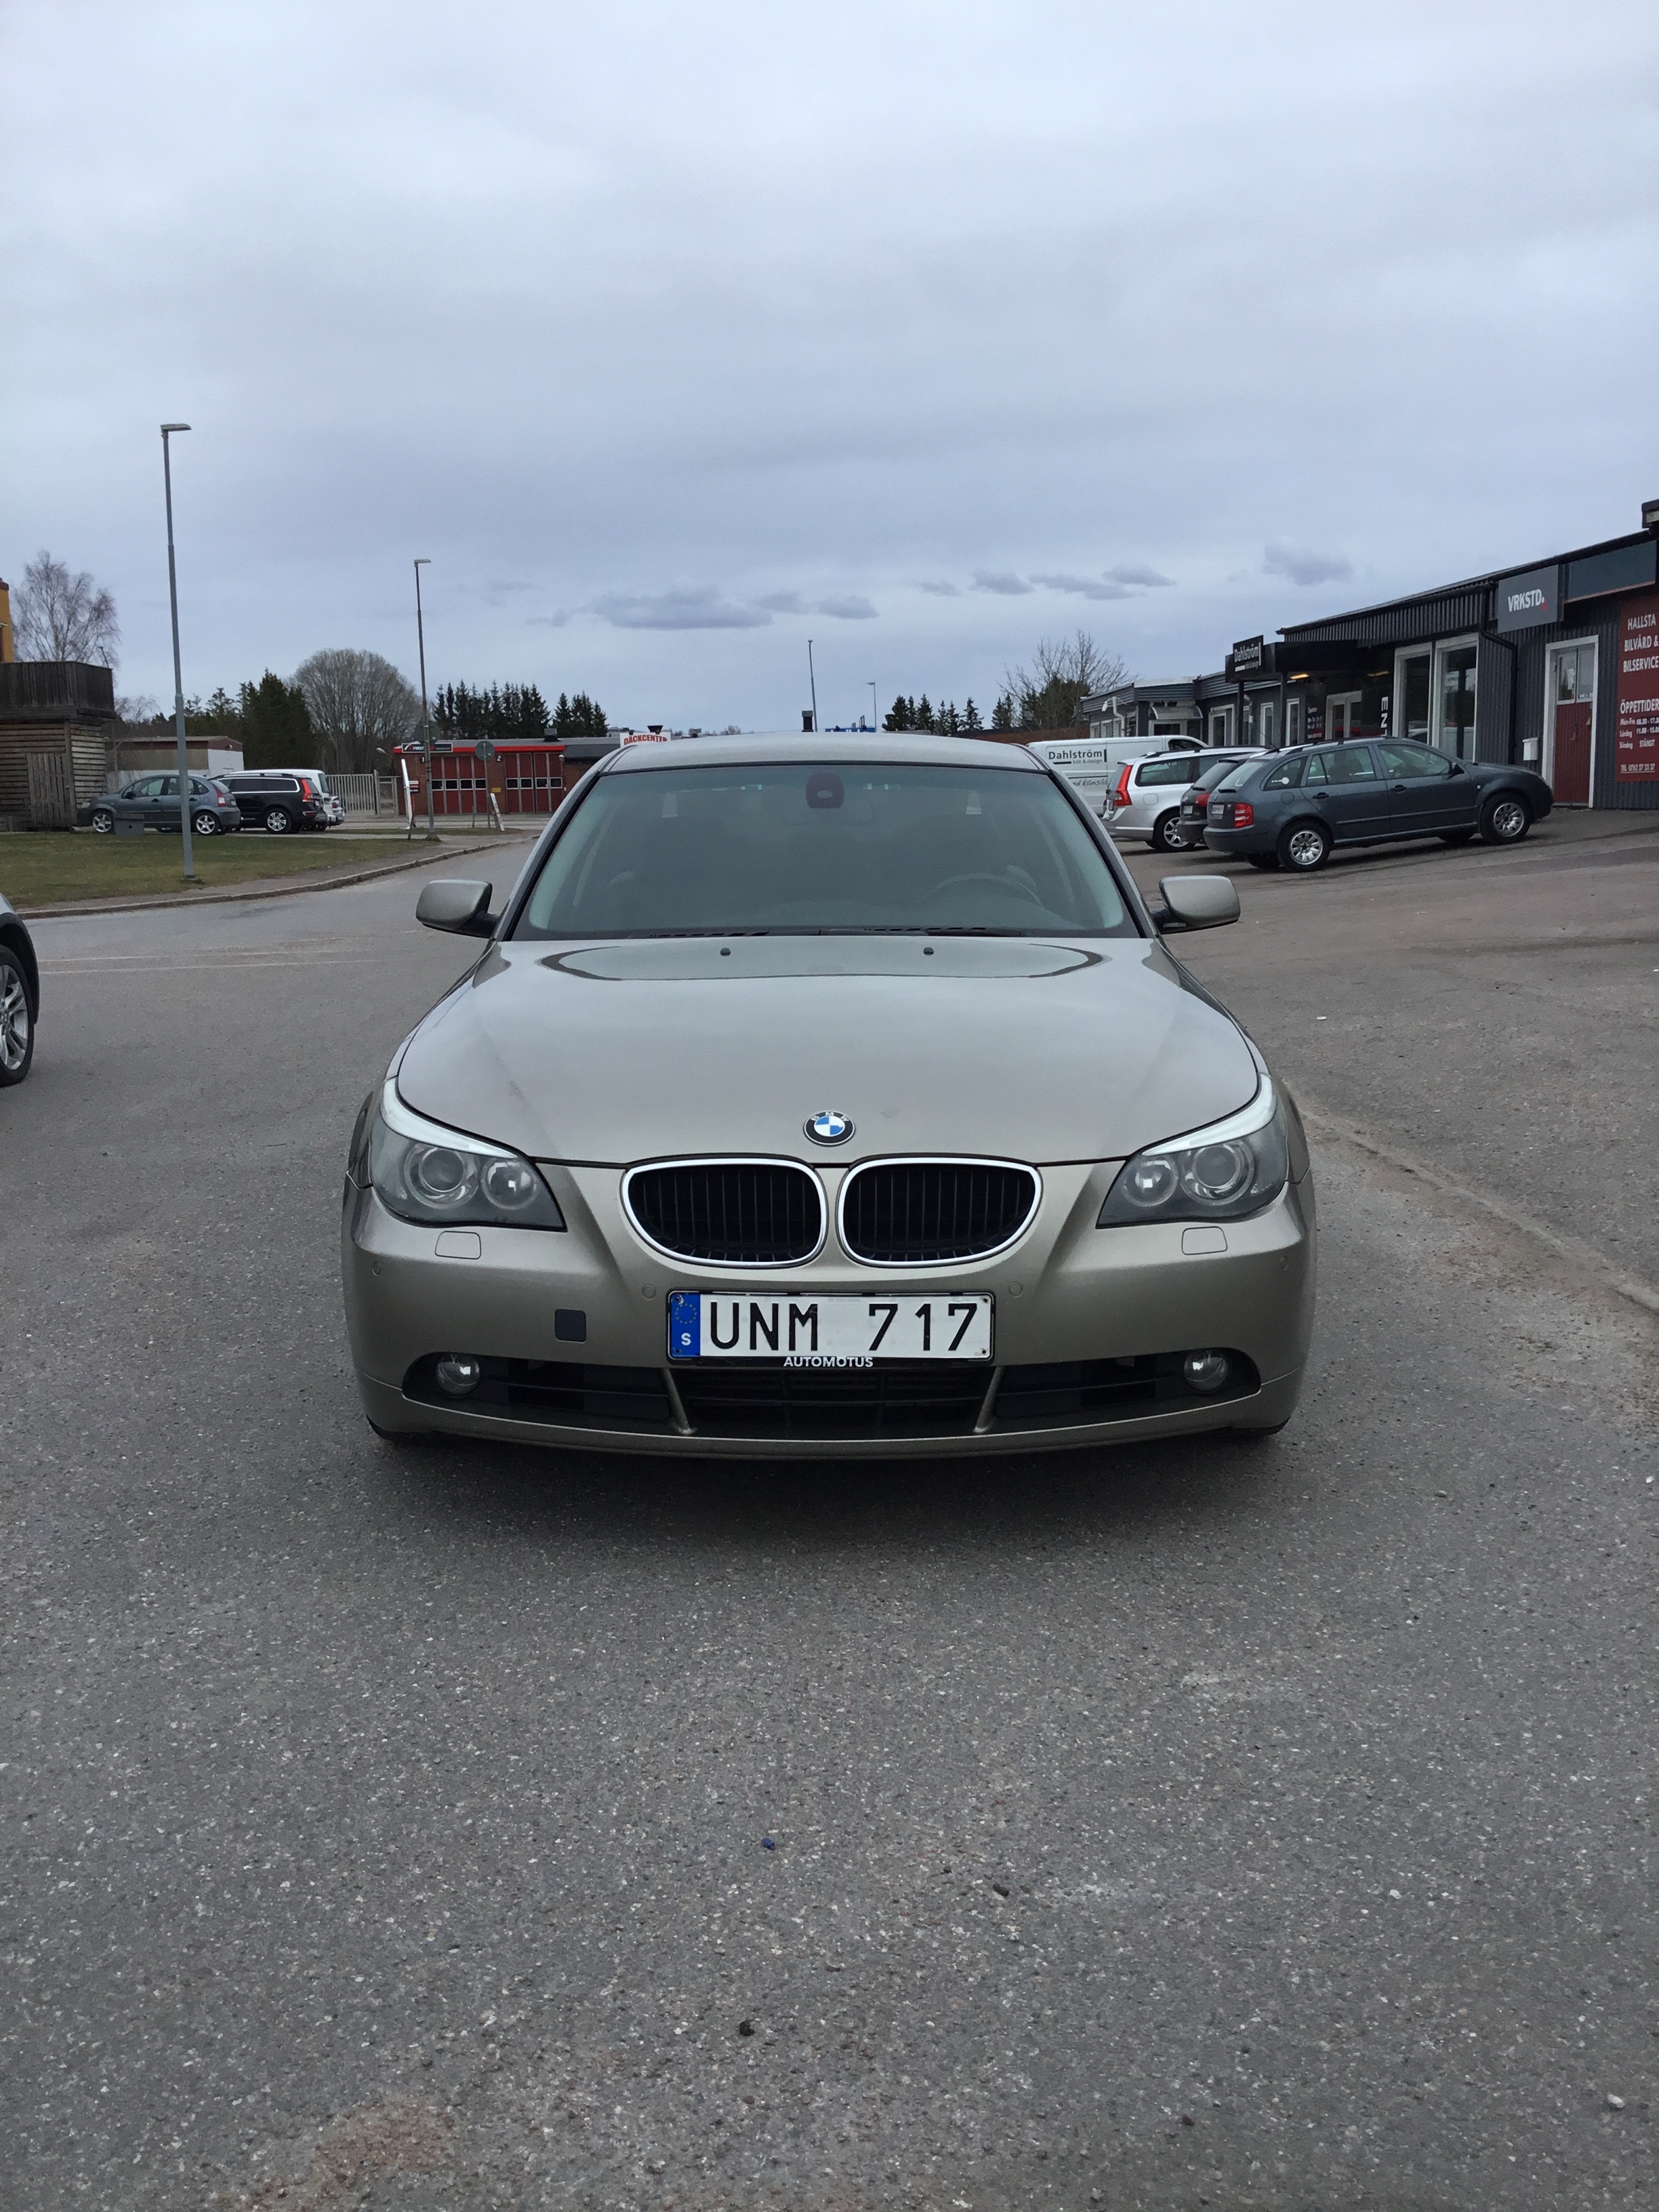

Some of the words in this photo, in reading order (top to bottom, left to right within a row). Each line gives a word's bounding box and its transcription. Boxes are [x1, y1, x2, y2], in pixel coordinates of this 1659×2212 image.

[1628, 613, 1656, 631] HALLSTA
[1624, 634, 1652, 652] BILVÅRD
[1654, 635, 1659, 647] &
[1623, 655, 1659, 673] BILSERVICE
[1620, 698, 1659, 714] ÖPPETTIDER
[1048, 749, 1103, 760] Dahlström
[811, 1111, 849, 1122] BMW
[710, 1301, 818, 1351] UNM
[868, 1303, 977, 1351] 717
[681, 1332, 691, 1346] S
[783, 1356, 874, 1368] AUTOMOTUS
